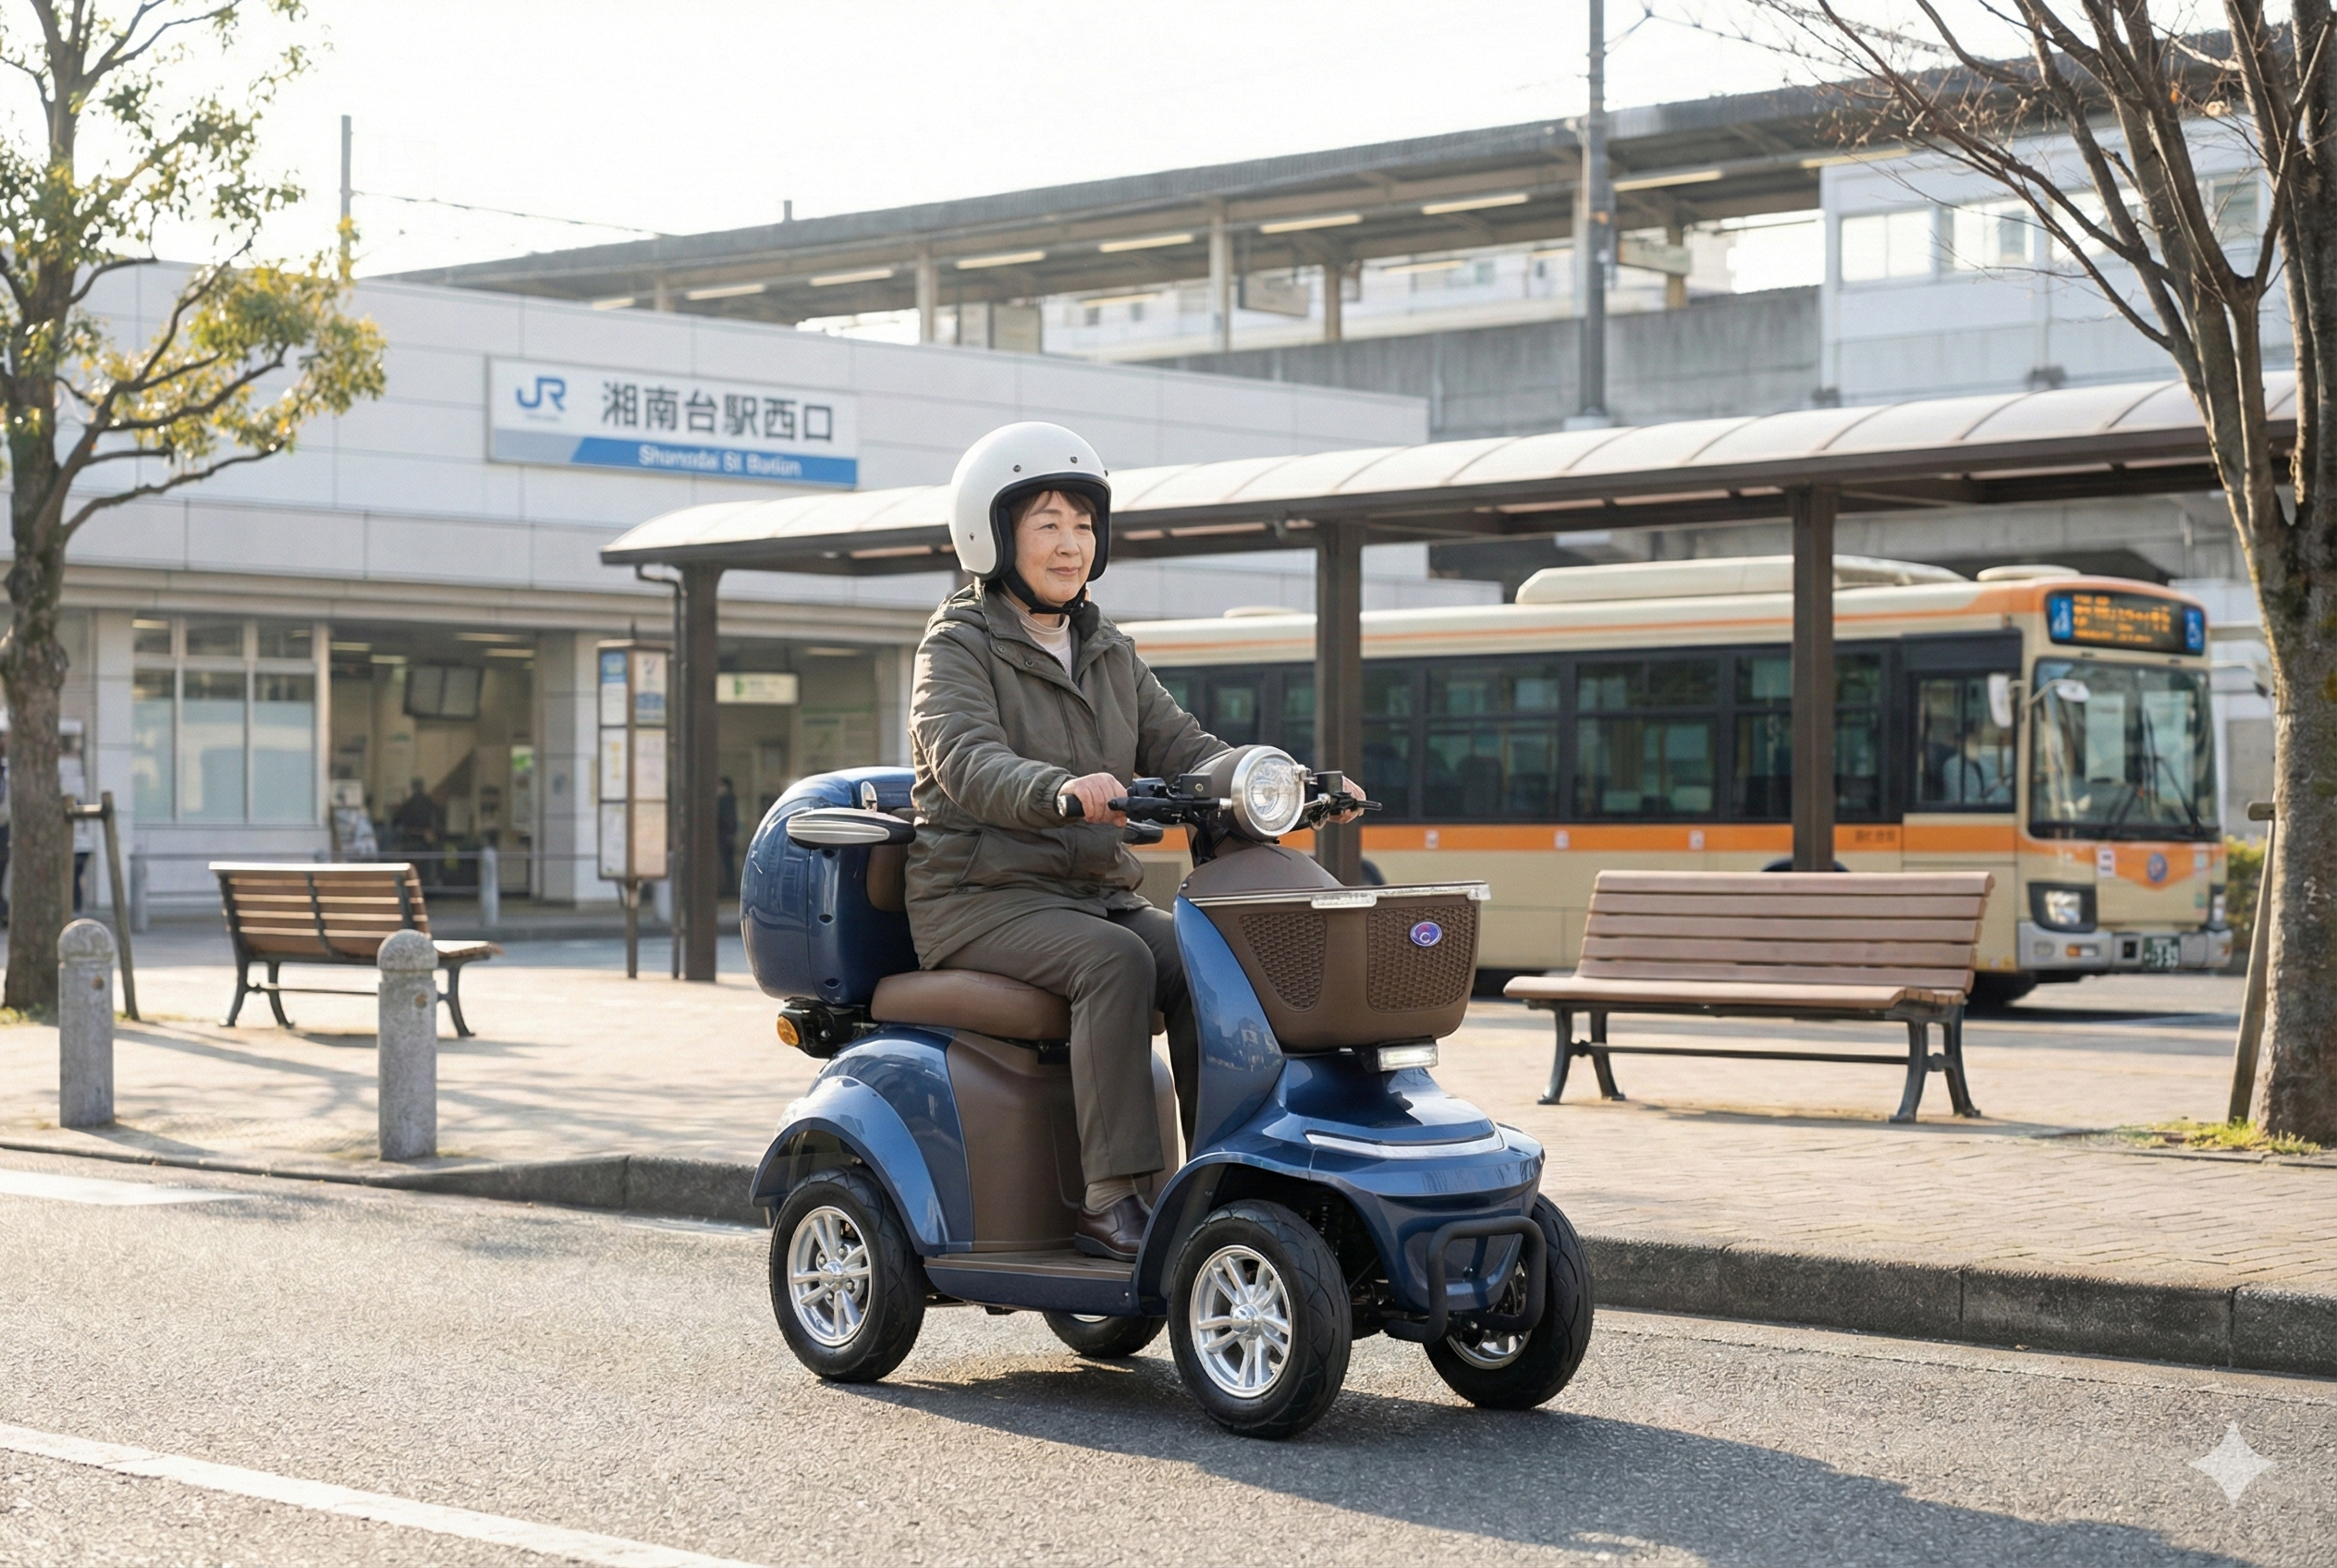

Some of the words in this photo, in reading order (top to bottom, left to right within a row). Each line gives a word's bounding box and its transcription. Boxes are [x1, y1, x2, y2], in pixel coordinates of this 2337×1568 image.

[517, 376, 566, 411] JR
[602, 381, 832, 442] 湘南台駅西口
